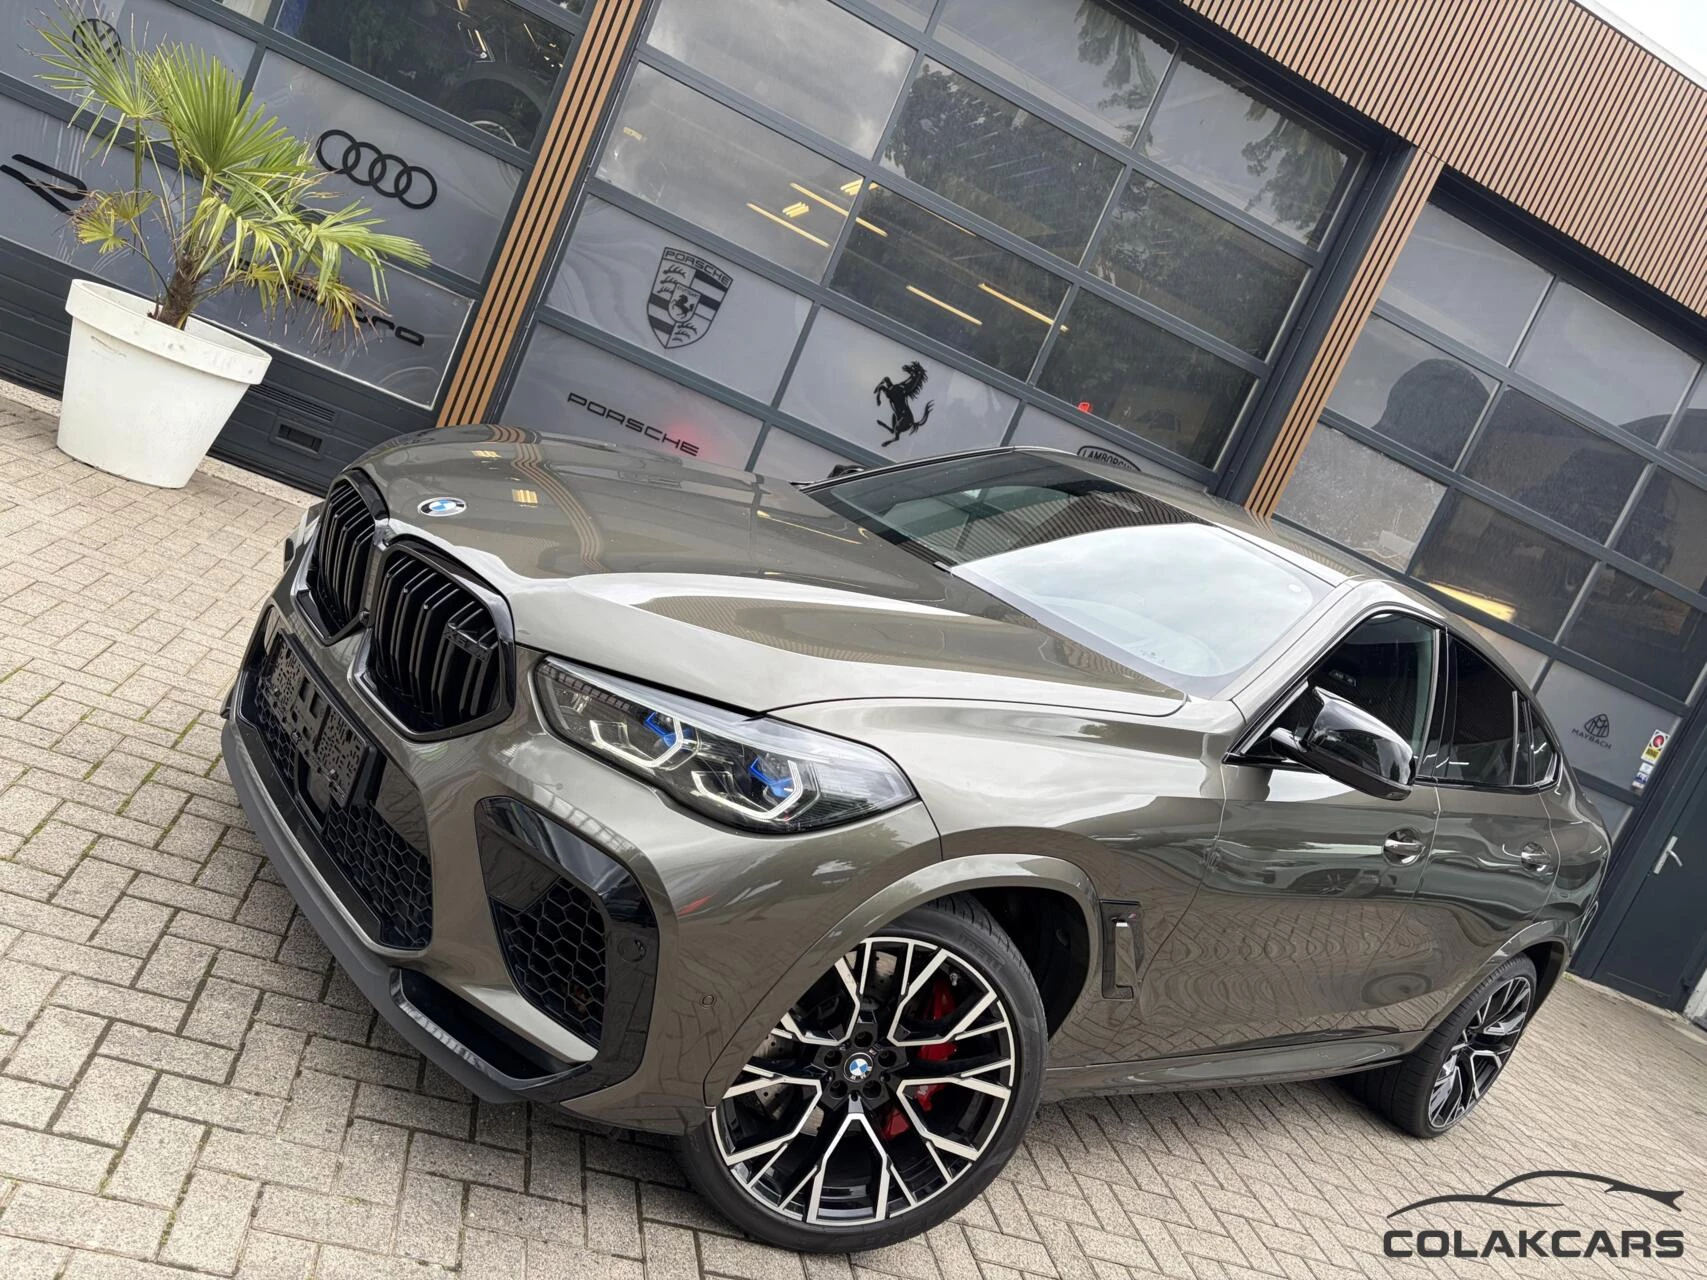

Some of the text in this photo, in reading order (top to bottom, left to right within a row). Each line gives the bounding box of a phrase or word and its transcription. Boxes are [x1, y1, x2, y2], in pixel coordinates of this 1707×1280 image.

[665, 250, 731, 287] PORSCHE
[567, 392, 700, 457] PORSCHE
[1571, 728, 1612, 749] MAYBACH
